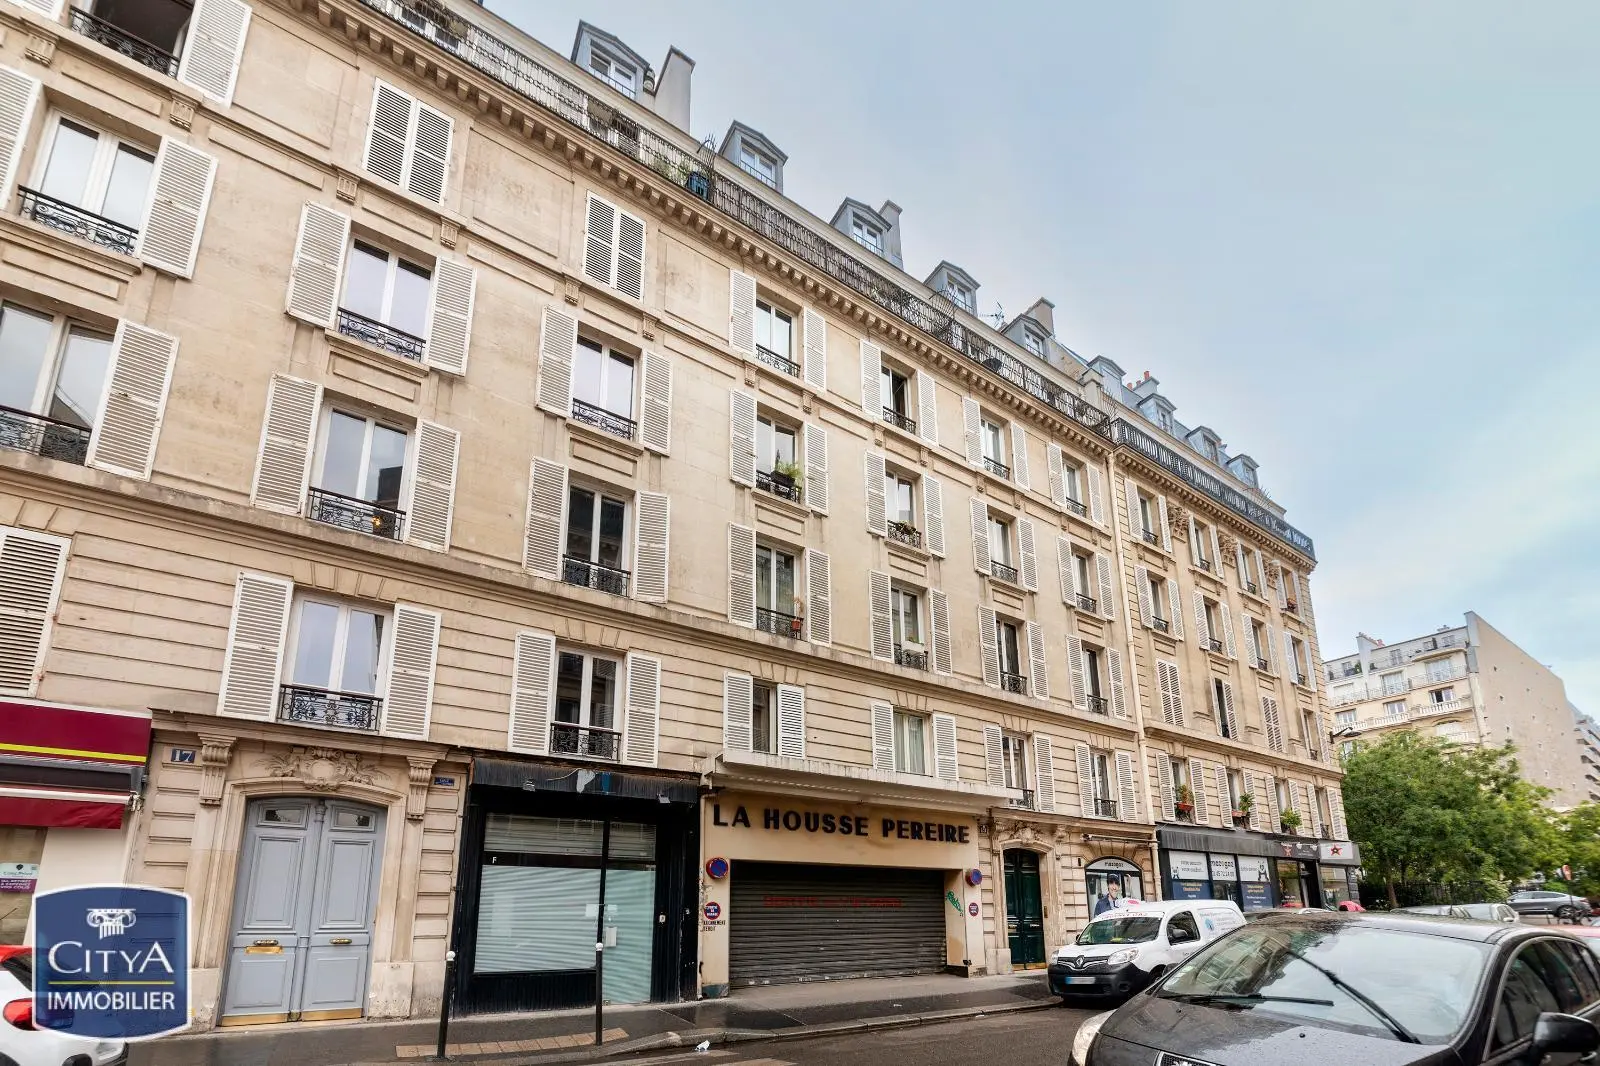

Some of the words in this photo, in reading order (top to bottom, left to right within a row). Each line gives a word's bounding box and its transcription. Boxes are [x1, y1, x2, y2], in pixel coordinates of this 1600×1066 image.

[173, 750, 193, 763] 17
[713, 804, 751, 828] LA
[764, 808, 869, 837] HOUSSE
[882, 818, 970, 844] PEREIRE
